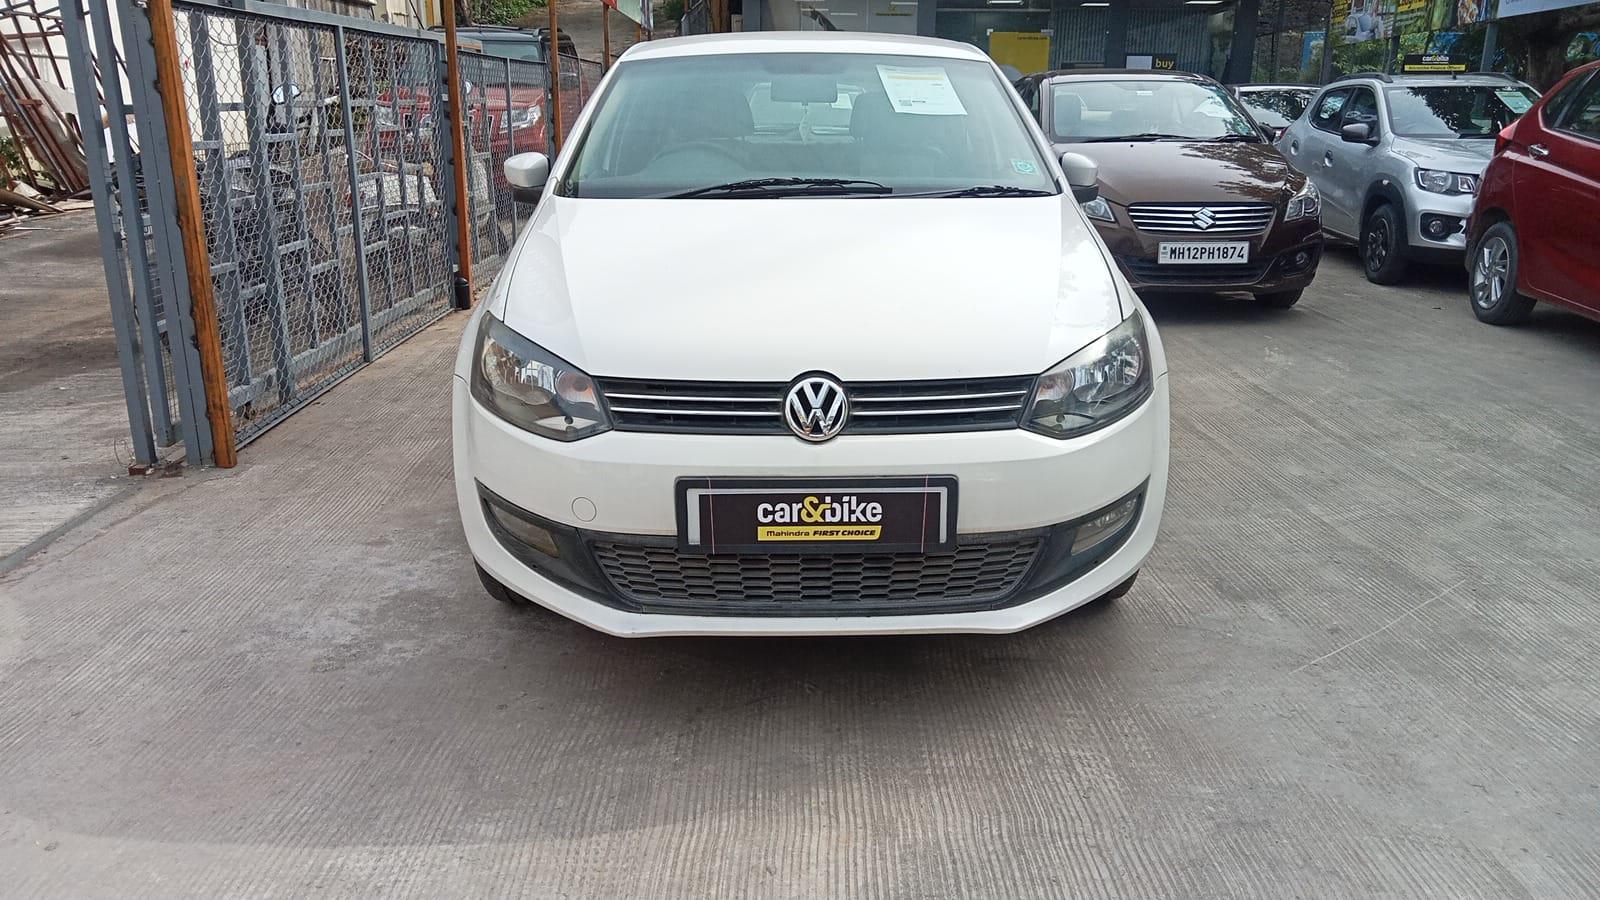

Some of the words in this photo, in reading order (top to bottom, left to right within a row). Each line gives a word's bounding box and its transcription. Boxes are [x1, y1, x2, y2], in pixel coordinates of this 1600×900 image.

[1155, 58, 1174, 70] buy
[1169, 246, 1245, 260] MH12PH1874
[757, 496, 883, 523] car&bike
